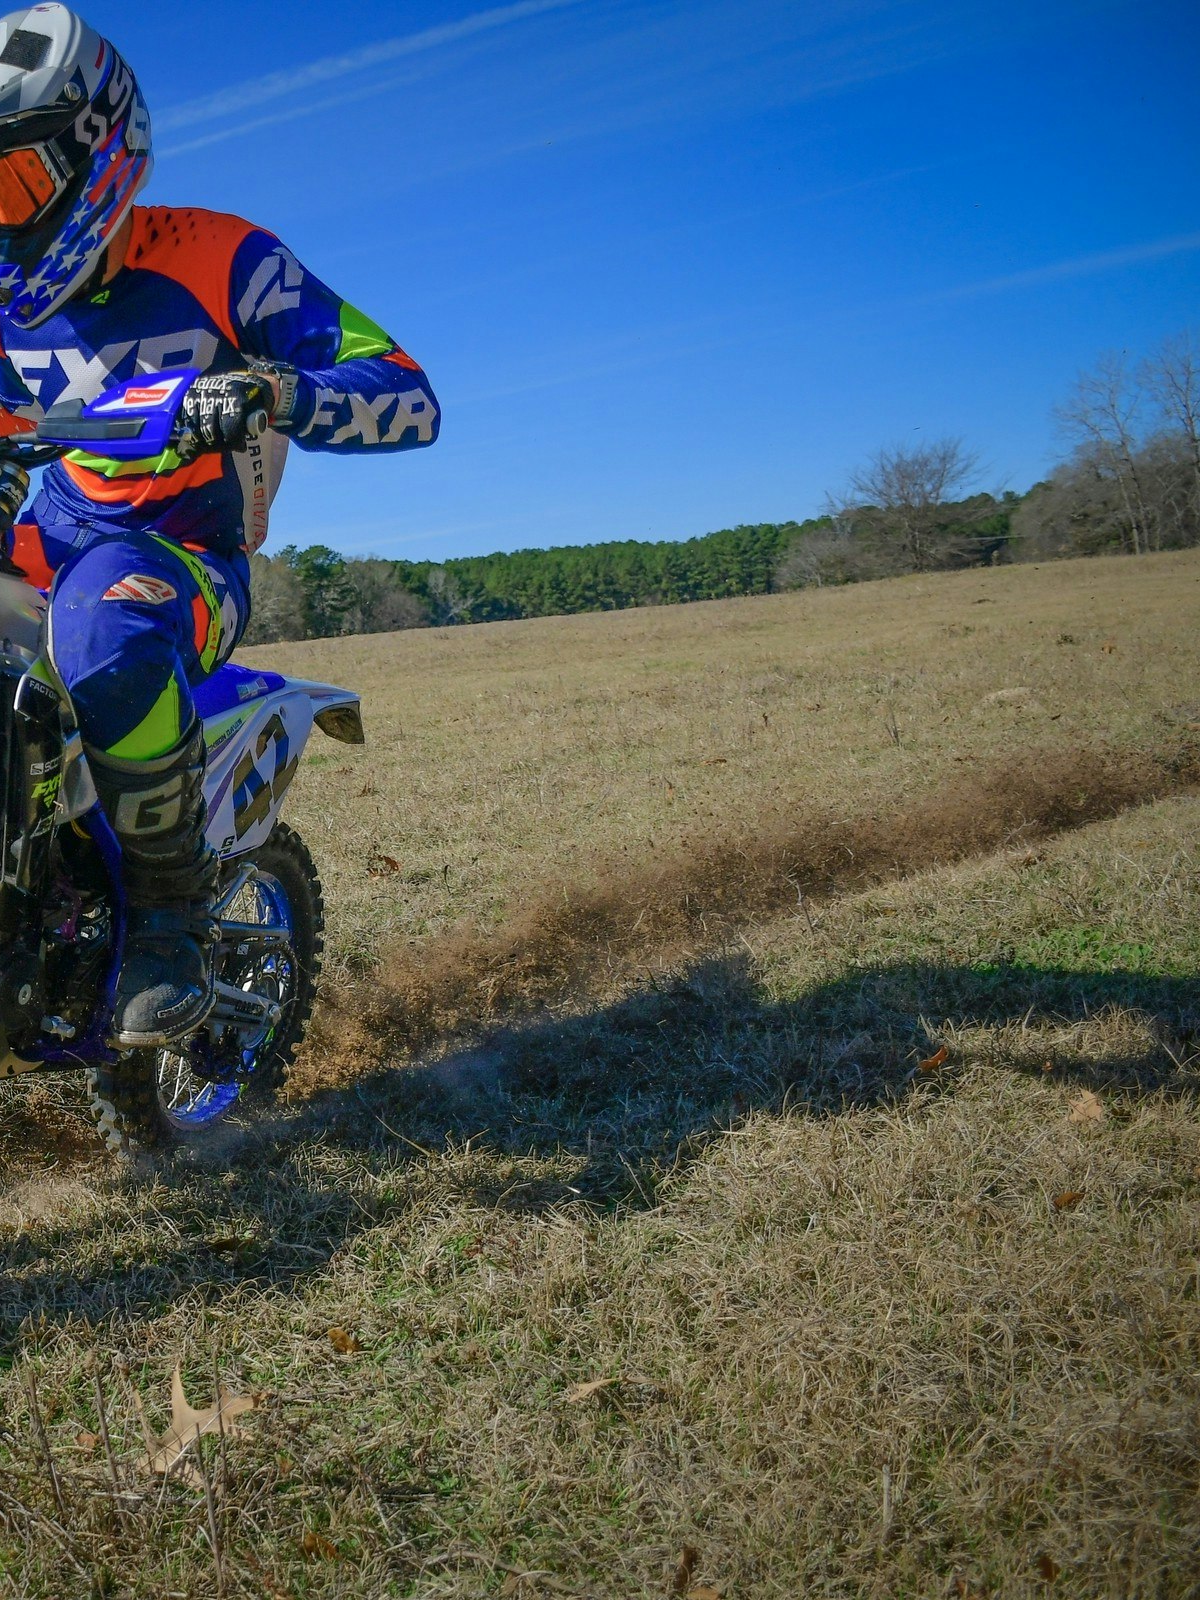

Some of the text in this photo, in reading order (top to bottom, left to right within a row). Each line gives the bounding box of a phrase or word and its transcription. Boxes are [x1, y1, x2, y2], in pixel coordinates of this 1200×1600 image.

[6, 328, 218, 420] FXR
[298, 387, 437, 445] FXR
[114, 774, 182, 835] G
[233, 714, 298, 842] 42
